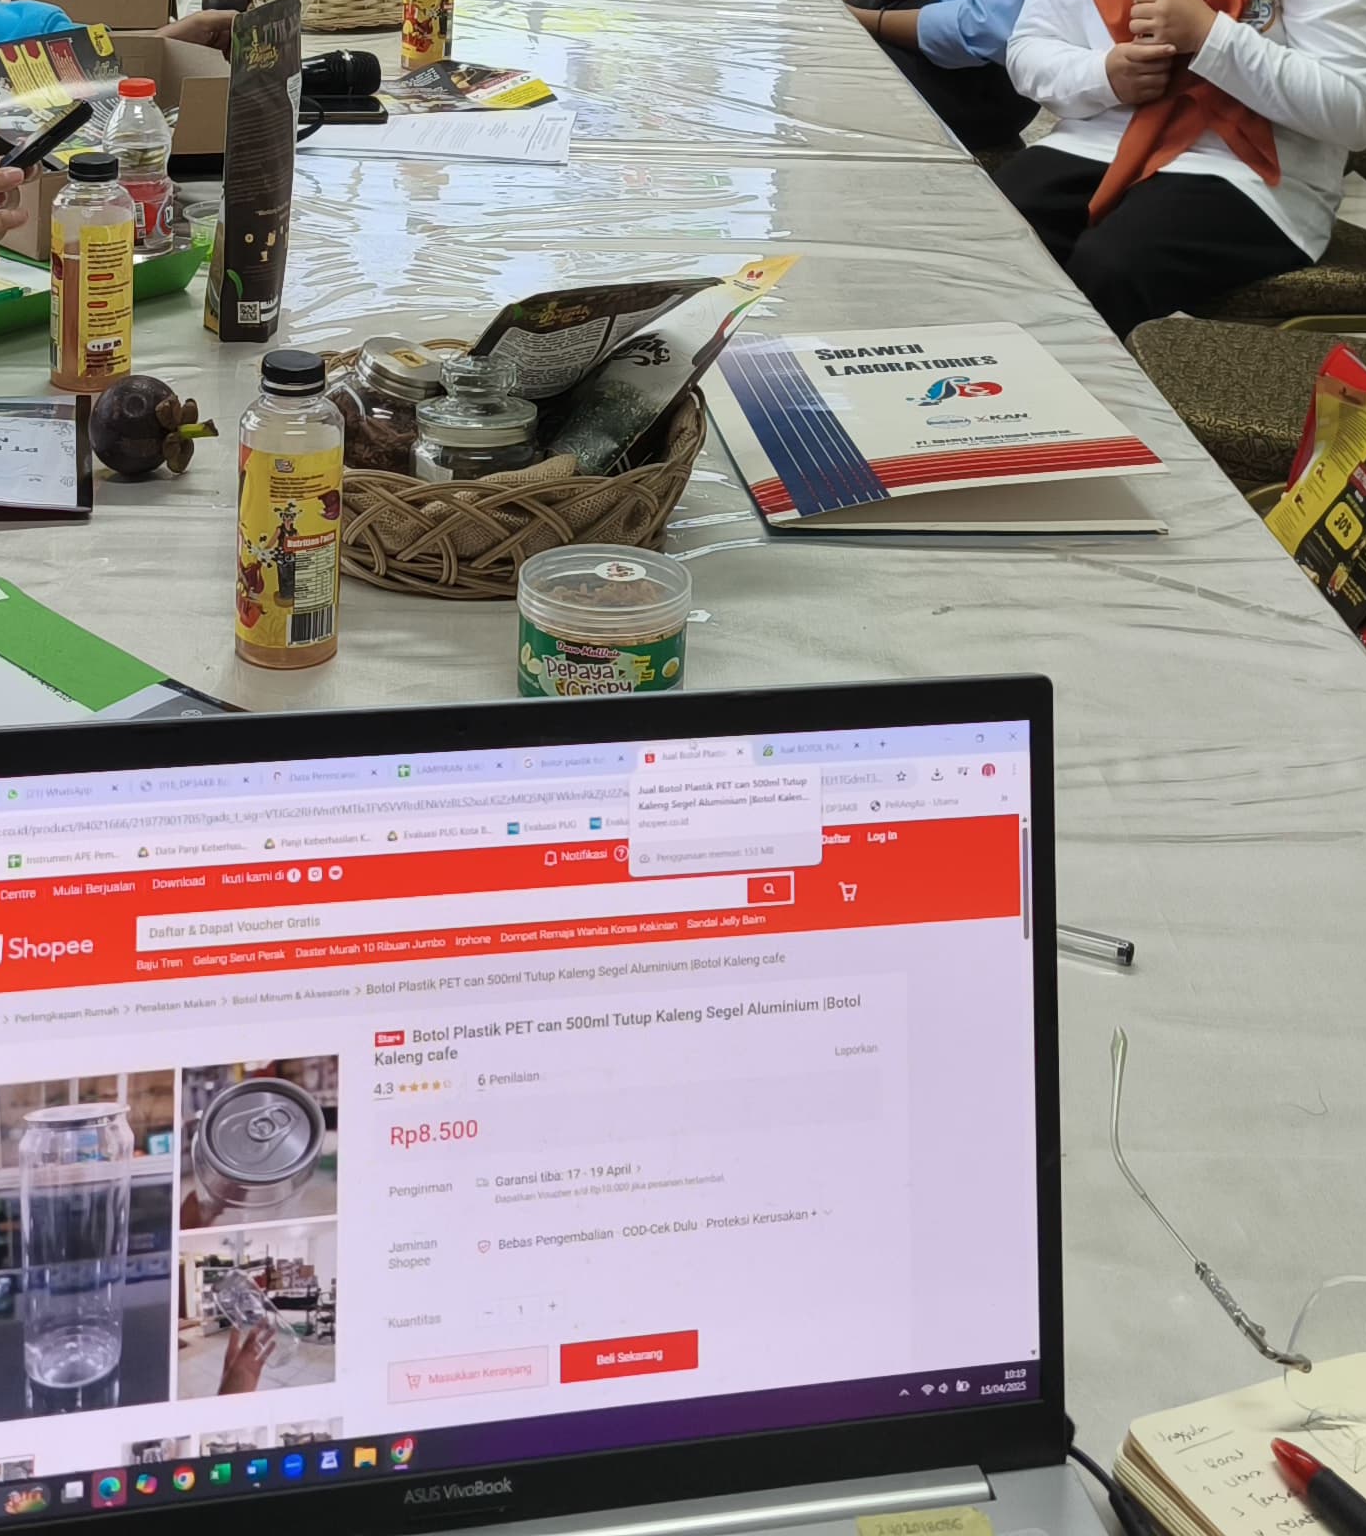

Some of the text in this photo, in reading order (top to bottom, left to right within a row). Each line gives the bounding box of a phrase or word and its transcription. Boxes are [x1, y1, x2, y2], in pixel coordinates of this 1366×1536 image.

[825, 356, 998, 376] LABORATORIES
[544, 657, 615, 679] Pepaya
[561, 848, 607, 862] Notifikasi
[53, 880, 135, 897] Mulai Berjualan
[152, 875, 205, 889] Download
[1, 888, 36, 901] Centre
[149, 924, 186, 940] Daftar
[199, 920, 233, 937] Dapat
[237, 917, 284, 932] Voucher
[287, 914, 320, 929] Gratis
[9, 935, 93, 963] Shopee
[296, 937, 446, 959] Daster Murah 10 Ribuan Jumbo
[137, 957, 182, 971] Baju Tren
[15, 952, 786, 1024] Perlengkapan Rumah Peralatan Makan Botol Minum Aksesoris Botol Plastik PET can 500ml Tutup Kaleng Segel Aluminium |Botol Kaleng cafe
[412, 1026, 449, 1042] Botol
[453, 1022, 501, 1040] Plastik
[506, 1020, 534, 1035] PET
[537, 1019, 562, 1033] can
[566, 1014, 609, 1030] 500ml
[613, 1011, 652, 1028] Tutup
[656, 1005, 702, 1024] Kaleng
[707, 1003, 744, 1021] Segel
[747, 995, 819, 1016] Aluminium
[375, 1045, 458, 1068] Kaleng cafe
[835, 1043, 878, 1057] Laporkan
[478, 1069, 540, 1086] 6 Penilaian
[374, 1081, 393, 1096] 4.3
[390, 1117, 478, 1149] Rp8.500
[495, 1162, 631, 1187] Garansi tiba: 17 19 April
[389, 1180, 453, 1199] Pengiriman
[498, 1208, 808, 1250] Bebas Pengembalian COD-Cek Dulu Proteksi Kerusakan
[389, 1237, 437, 1254] Jaminan
[389, 1254, 430, 1269] Shopee
[388, 1313, 441, 1328] Kuantitas
[597, 1347, 663, 1366] Beli Sekarang
[428, 1361, 531, 1385] Masukkan Keranjang
[404, 1477, 512, 1505] ASUS VivoBook
